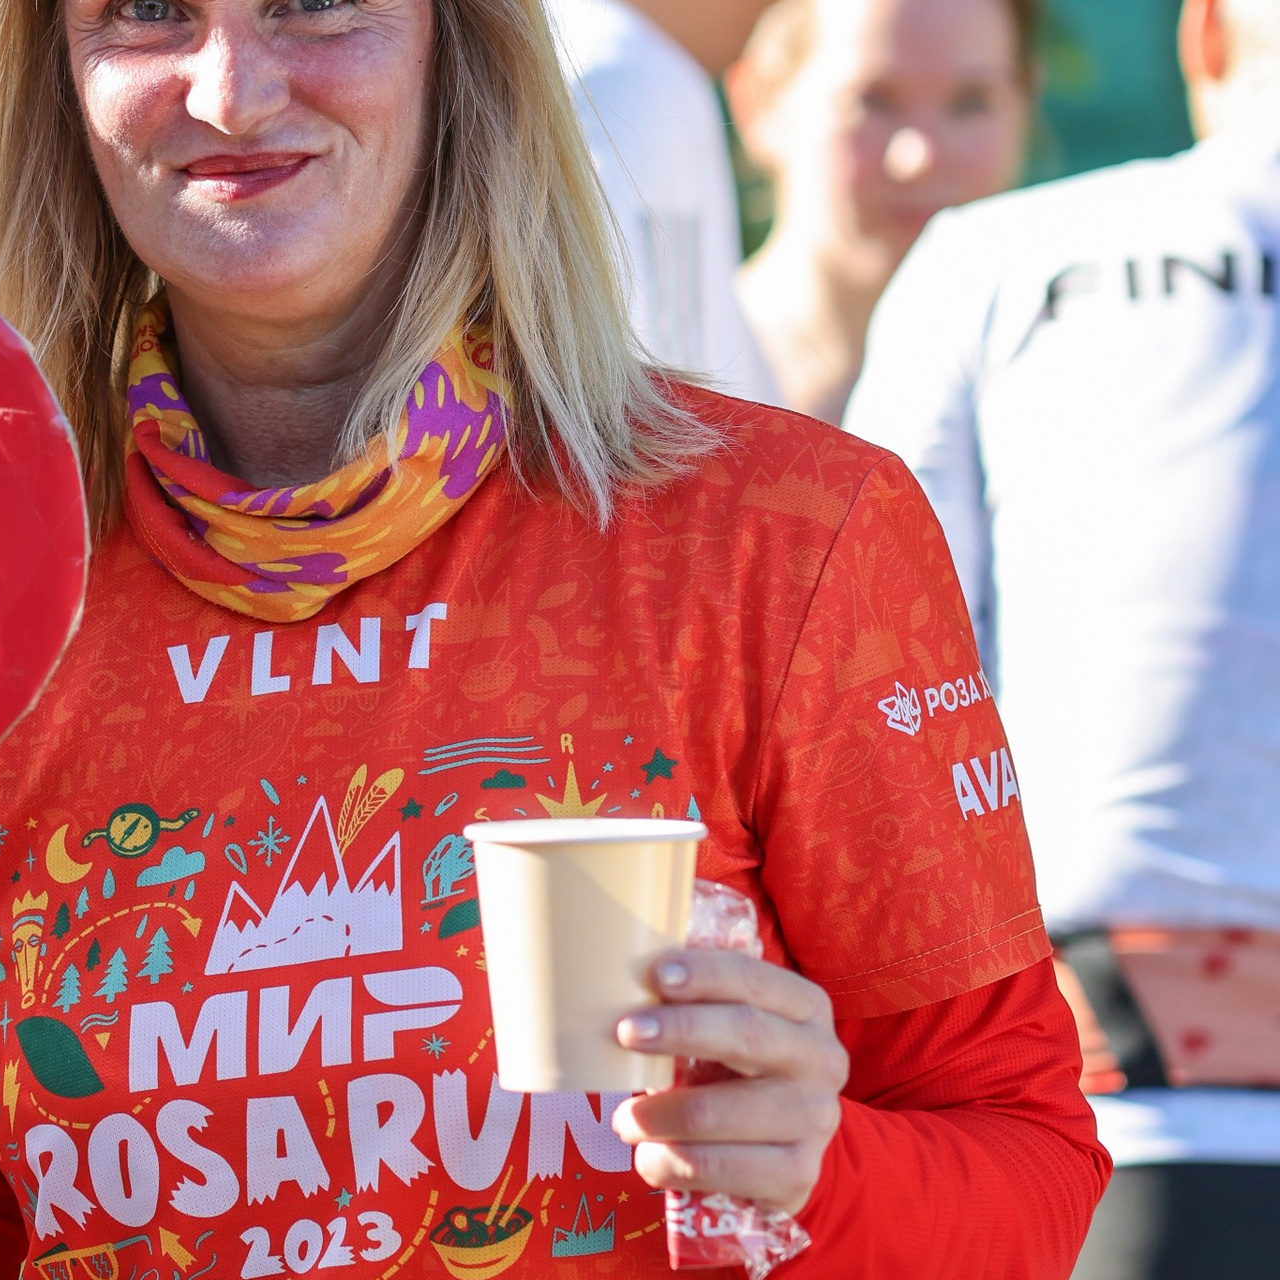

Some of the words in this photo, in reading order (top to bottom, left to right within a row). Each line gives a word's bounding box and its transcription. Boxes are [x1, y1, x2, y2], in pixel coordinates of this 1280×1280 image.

[167, 602, 448, 705] VLNT
[923, 674, 982, 718] РОЗА
[24, 1094, 332, 1240] ROSA
[238, 1210, 403, 1280] 2023
